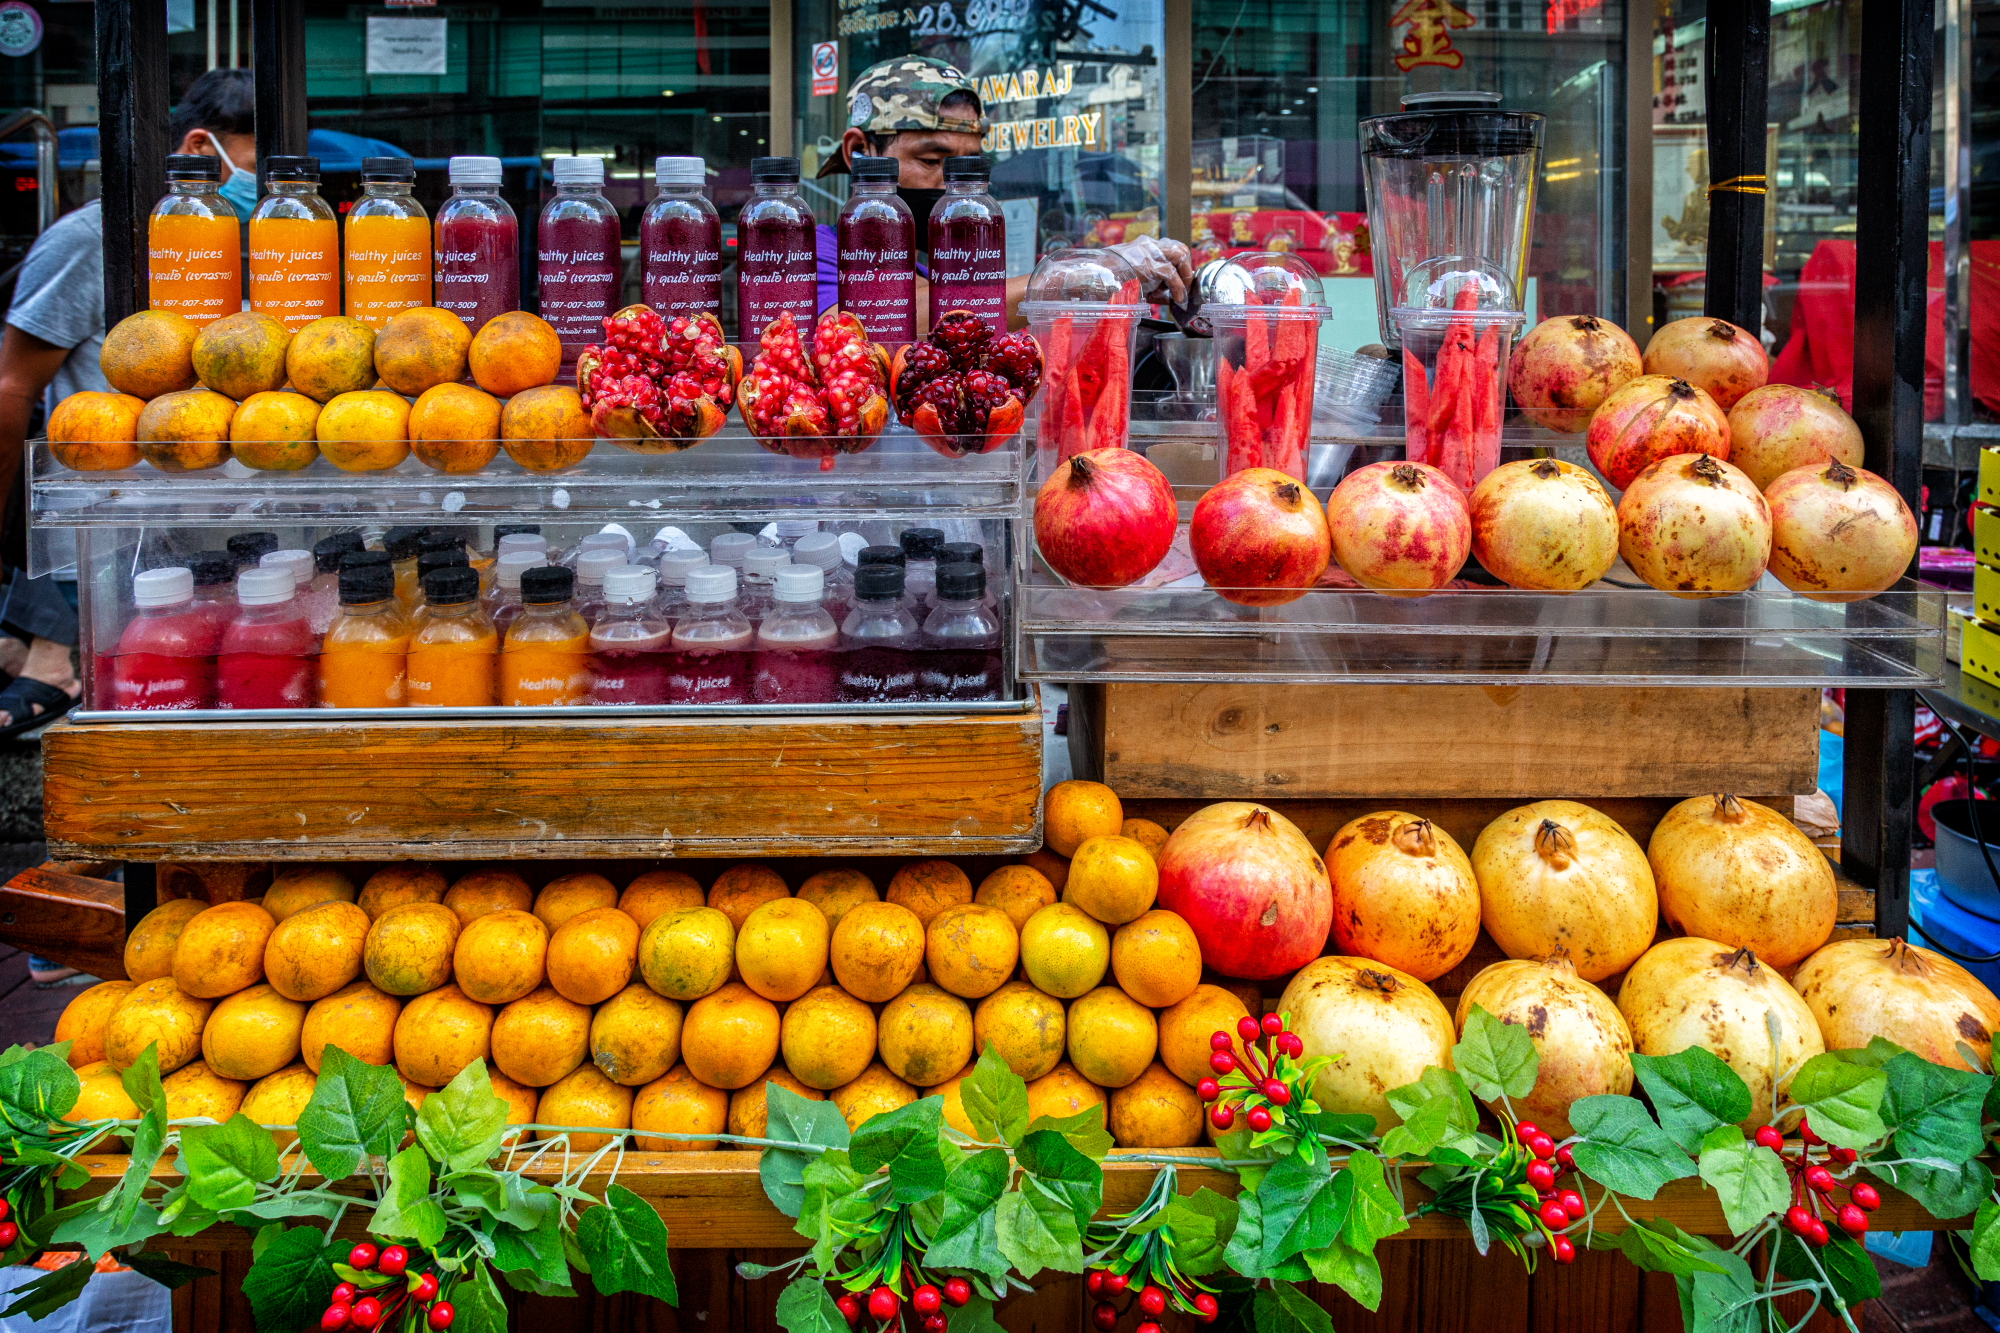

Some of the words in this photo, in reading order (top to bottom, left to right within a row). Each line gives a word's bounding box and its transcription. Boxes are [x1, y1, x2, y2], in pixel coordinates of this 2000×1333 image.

[1387, 0, 1476, 73] 金
[980, 112, 1101, 154] JEWELRY
[185, 248, 223, 262] juices
[287, 249, 324, 264] juices
[349, 249, 388, 264] Healthy
[390, 249, 423, 264] juices
[445, 250, 477, 265] juices
[570, 250, 605, 265] juices
[649, 250, 691, 265] Healthy
[693, 250, 719, 265] juices
[744, 249, 783, 265] Healthy
[785, 249, 813, 265] juices
[840, 248, 876, 264] Healthy
[878, 248, 908, 264] juices
[934, 247, 971, 263] Healthy
[973, 247, 1001, 263] juices
[646, 271, 656, 287] By
[741, 271, 750, 286] By
[931, 268, 940, 284] By
[163, 299, 224, 307] 097-007-5009
[265, 300, 324, 308] 097-007-5009
[367, 301, 423, 309] 097-007-5009
[550, 301, 605, 309] 097-007-5009
[670, 301, 720, 310] 097-007-5009
[764, 300, 813, 309] 097-007-5009
[845, 300, 855, 308] Tel.
[857, 299, 909, 308] 097-007-5009
[939, 299, 949, 307] Tel.
[951, 298, 1001, 307] 097-007-5009
